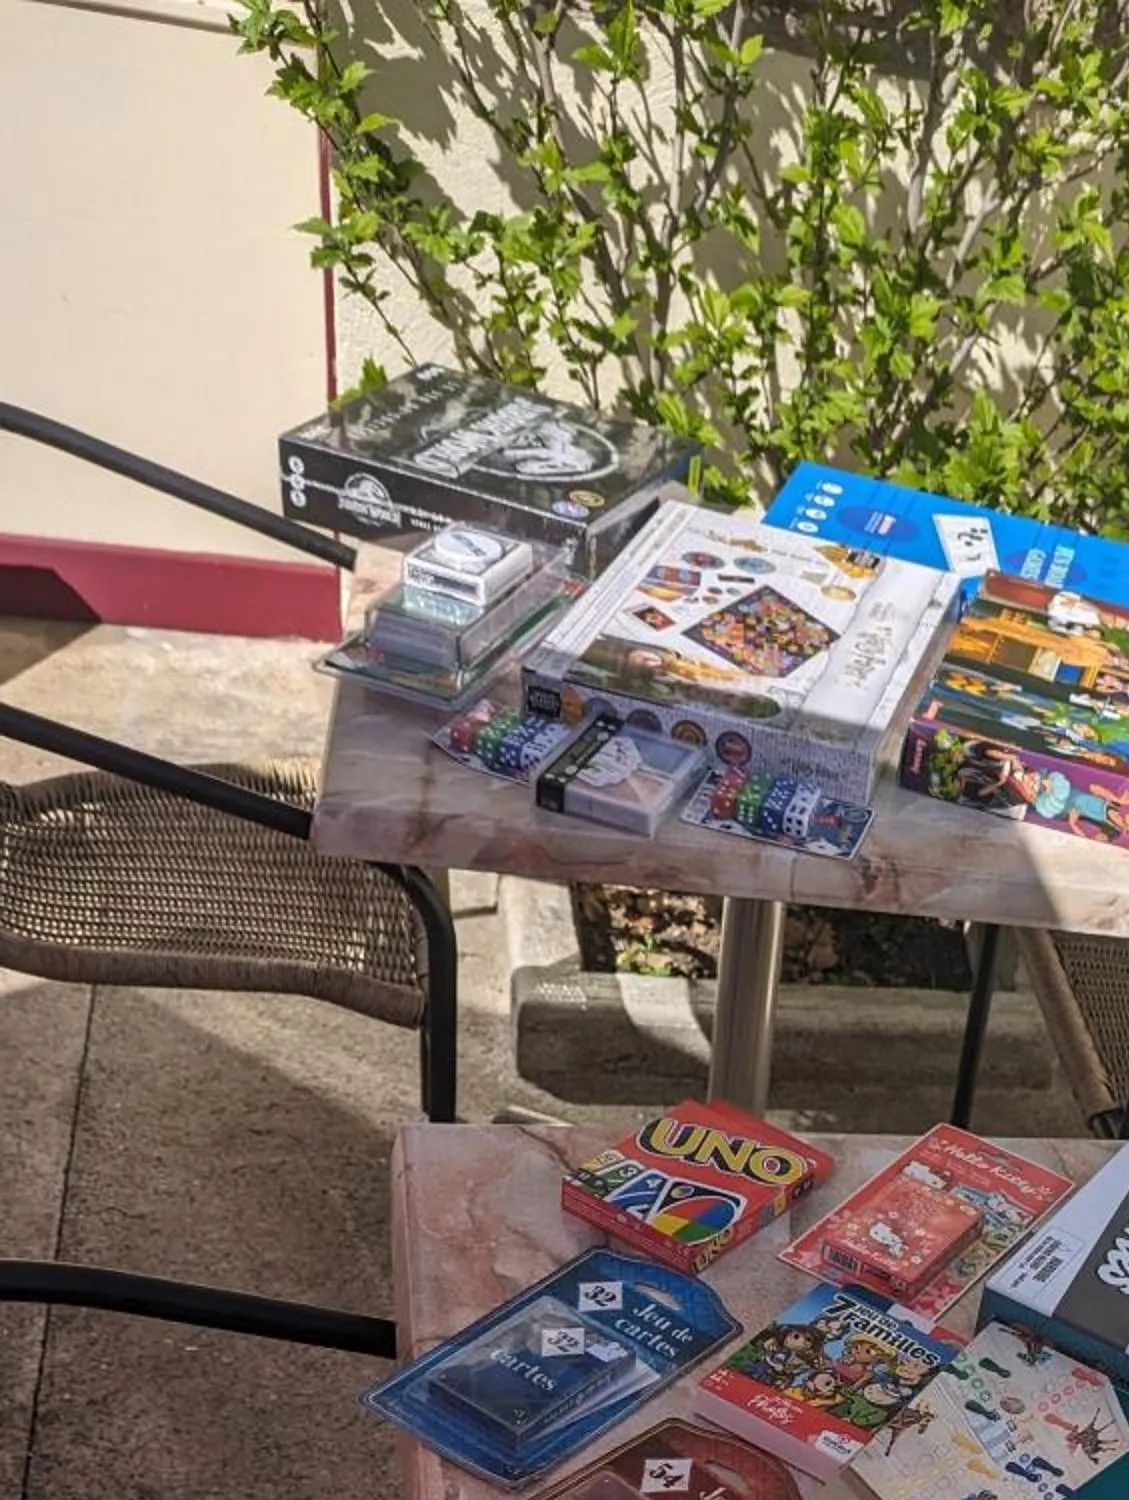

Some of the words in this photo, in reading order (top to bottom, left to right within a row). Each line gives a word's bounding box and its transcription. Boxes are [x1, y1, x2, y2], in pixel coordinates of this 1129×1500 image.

[648, 1117, 805, 1185] UNO
[583, 1284, 617, 1308] 32
[547, 1331, 580, 1354] 32
[614, 1317, 680, 1359] cartes
[631, 1302, 668, 1334] Jeu
[671, 1325, 694, 1344] de
[842, 1314, 941, 1367] Familles
[490, 1349, 556, 1393] cartes
[649, 1463, 684, 1489] 54
